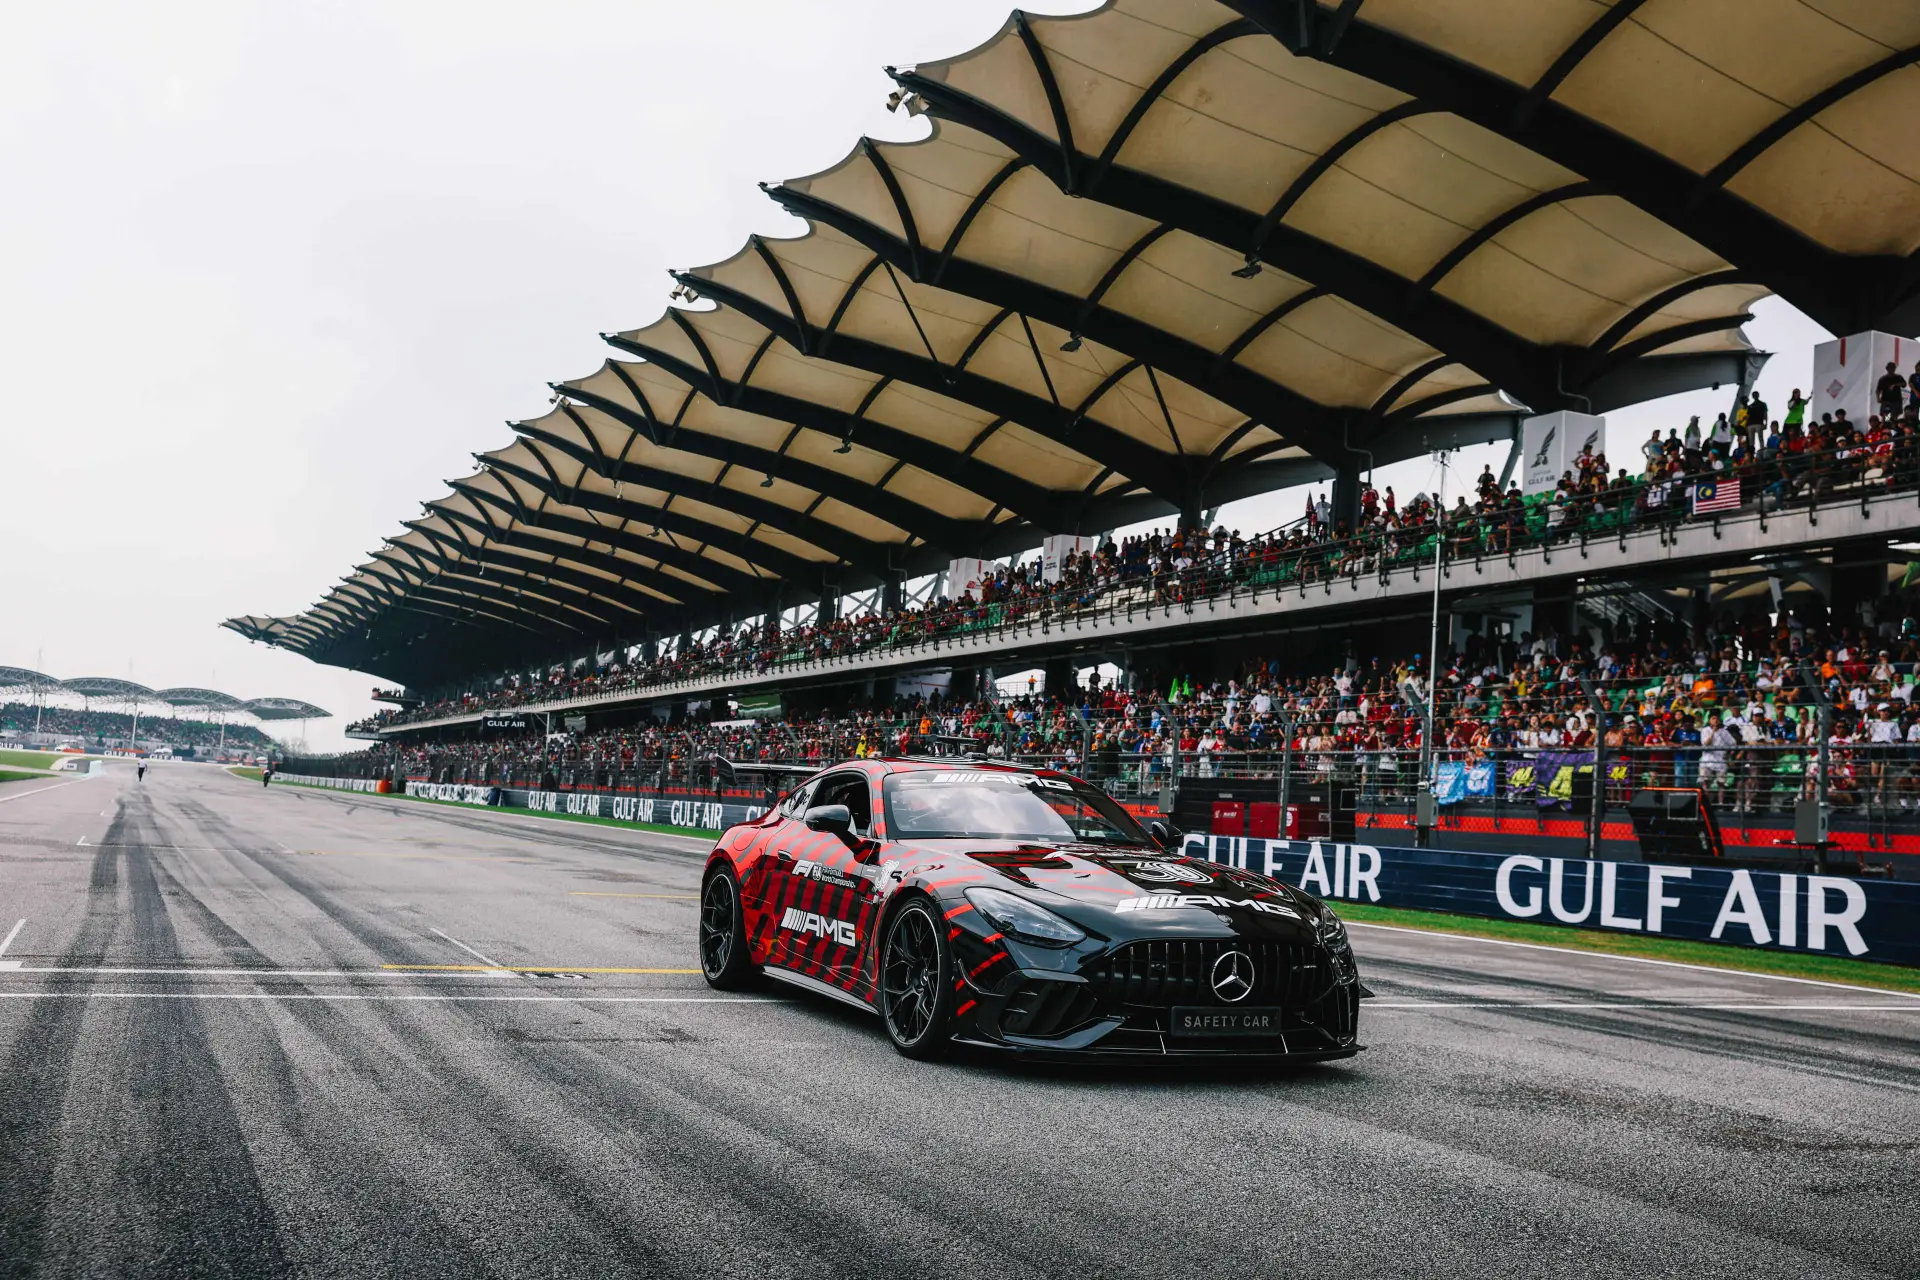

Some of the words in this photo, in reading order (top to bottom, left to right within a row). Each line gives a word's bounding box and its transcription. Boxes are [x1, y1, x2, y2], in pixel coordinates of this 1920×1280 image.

[976, 773, 1074, 792] AMG
[528, 790, 545, 810] GULF
[545, 791, 557, 812] AIR
[567, 793, 586, 814] GULF
[586, 794, 600, 817] AIR
[612, 797, 637, 820] GULF
[637, 798, 654, 823] AIR
[671, 800, 701, 827] GULF
[701, 802, 723, 830] AIR
[1299, 842, 1381, 902] AIR
[1175, 895, 1301, 919] AMG
[1496, 855, 1692, 933] GULF
[1710, 869, 1870, 956] AIR
[802, 913, 856, 948] AMG
[1184, 1015, 1238, 1028] SAFETY
[1243, 1015, 1269, 1028] CAR
